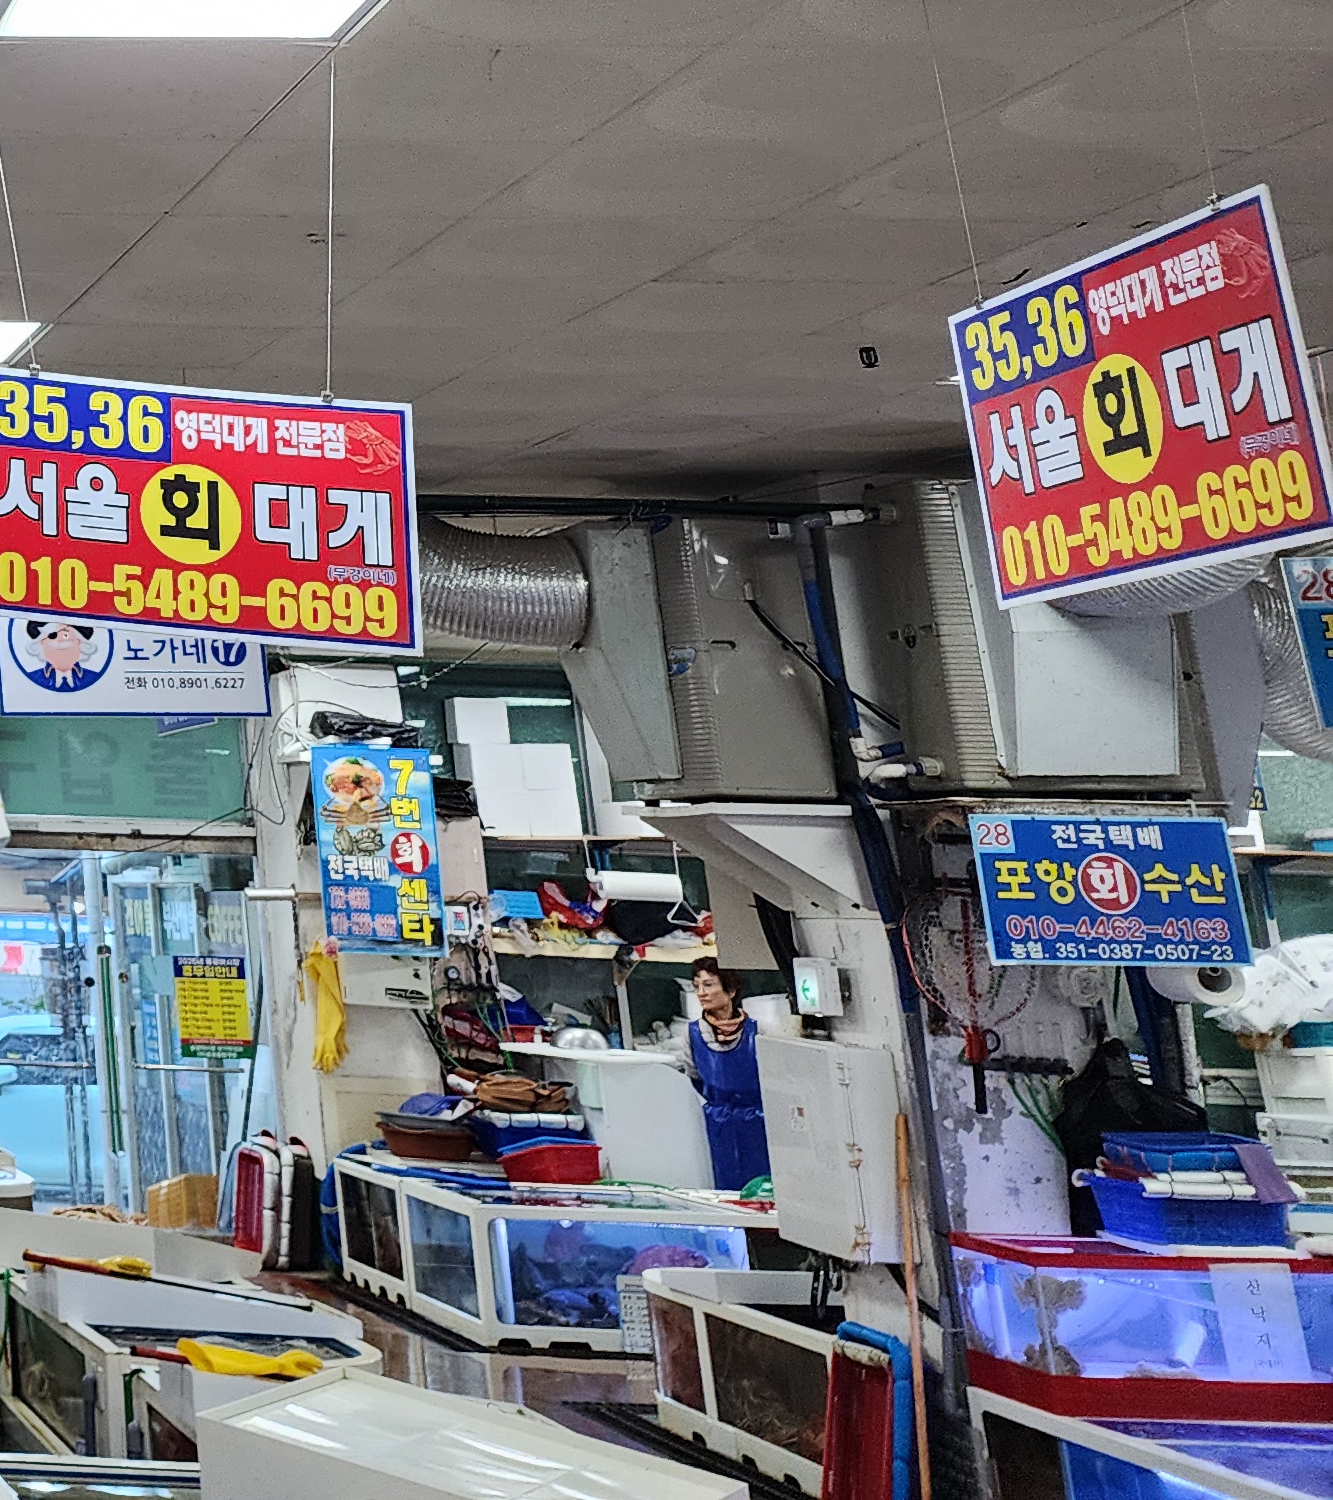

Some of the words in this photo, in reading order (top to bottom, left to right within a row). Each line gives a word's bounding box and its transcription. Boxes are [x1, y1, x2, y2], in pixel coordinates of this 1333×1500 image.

[1088, 265, 1164, 336] 영덕대게
[1162, 240, 1227, 307] 전문점
[965, 284, 1088, 392] 35,36
[989, 386, 1085, 497] 서울
[1091, 365, 1153, 459] 회
[1160, 316, 1293, 443] 대게
[174, 410, 269, 455] 영덕대게
[274, 418, 347, 461] 전문점
[159, 473, 222, 552] 회
[252, 481, 395, 568] 대게
[1001, 448, 1315, 587] 010-5489-6699
[122, 637, 208, 664] 노가네
[213, 640, 243, 663] 17
[124, 677, 148, 690] 전화
[151, 677, 245, 690] 010.8901.6227
[388, 758, 423, 830] 7번
[394, 833, 424, 874] 회
[975, 823, 1012, 847] 28
[1050, 824, 1164, 851] 전국택배
[993, 859, 1077, 906] 포항
[1085, 860, 1131, 905] 회
[1142, 861, 1228, 905] 수산
[396, 878, 435, 947] 센타
[1006, 915, 1231, 942] 010-4462-4163
[1055, 944, 1234, 961] 351-0387-0507-23
